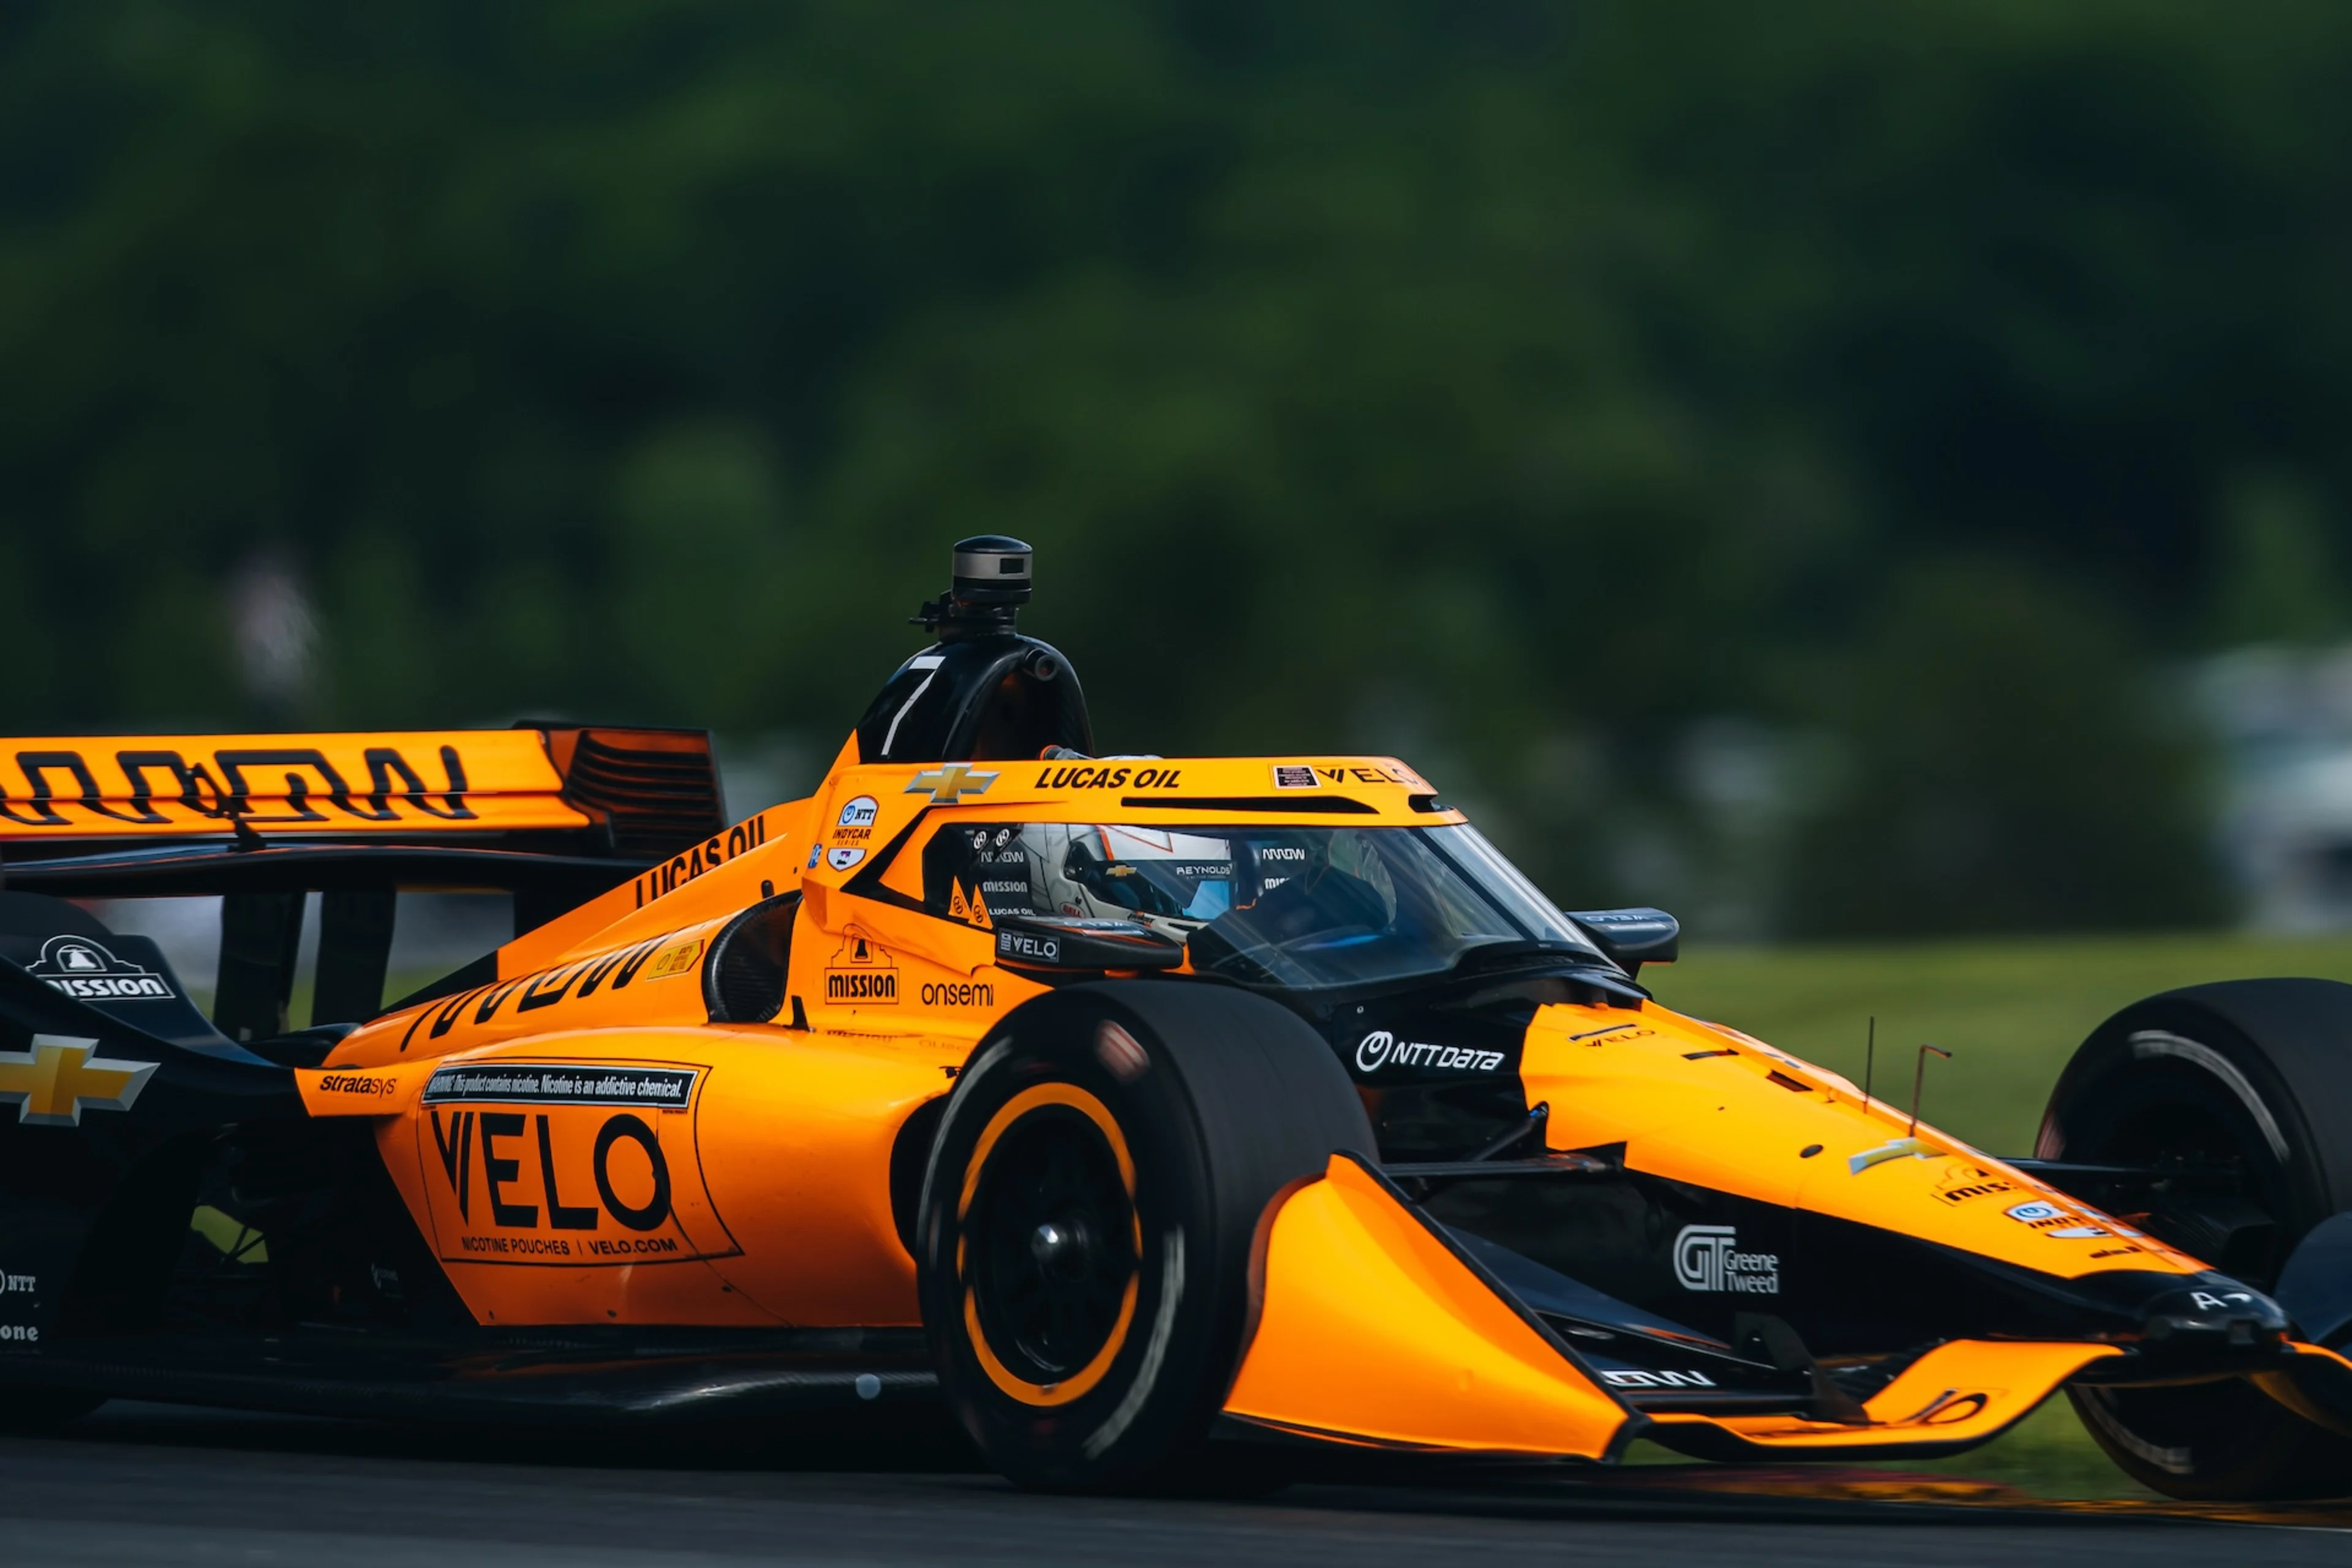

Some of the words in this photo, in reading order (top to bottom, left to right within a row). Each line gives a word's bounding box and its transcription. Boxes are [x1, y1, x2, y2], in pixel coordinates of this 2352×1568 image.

[881, 656, 946, 756] 7
[1035, 767, 1131, 788] LUCAS
[1133, 769, 1181, 788] OIL
[854, 809, 874, 820] NTT
[832, 829, 871, 840] INDYCAR
[636, 838, 722, 910] LUCAS
[1177, 865, 1231, 875] REYNOLDS
[982, 881, 1027, 892] MISSION
[1013, 937, 1057, 957] VELO
[829, 975, 895, 998] MISSION
[922, 983, 993, 1006] onsemi
[320, 1074, 397, 1098] stratasys
[541, 1074, 573, 1094] Nicotine
[574, 1076, 582, 1094] is
[582, 1079, 595, 1095] an
[595, 1076, 636, 1095] addictive
[637, 1077, 682, 1097] chemical.
[431, 1110, 671, 1231] VELO
[461, 1236, 509, 1253] NICOTINE
[511, 1238, 570, 1255] POUCHES
[588, 1238, 678, 1254] VELO.COM
[1724, 1250, 1779, 1272] Greene
[7, 1275, 36, 1292] NTT
[1725, 1271, 1779, 1294] Tweed
